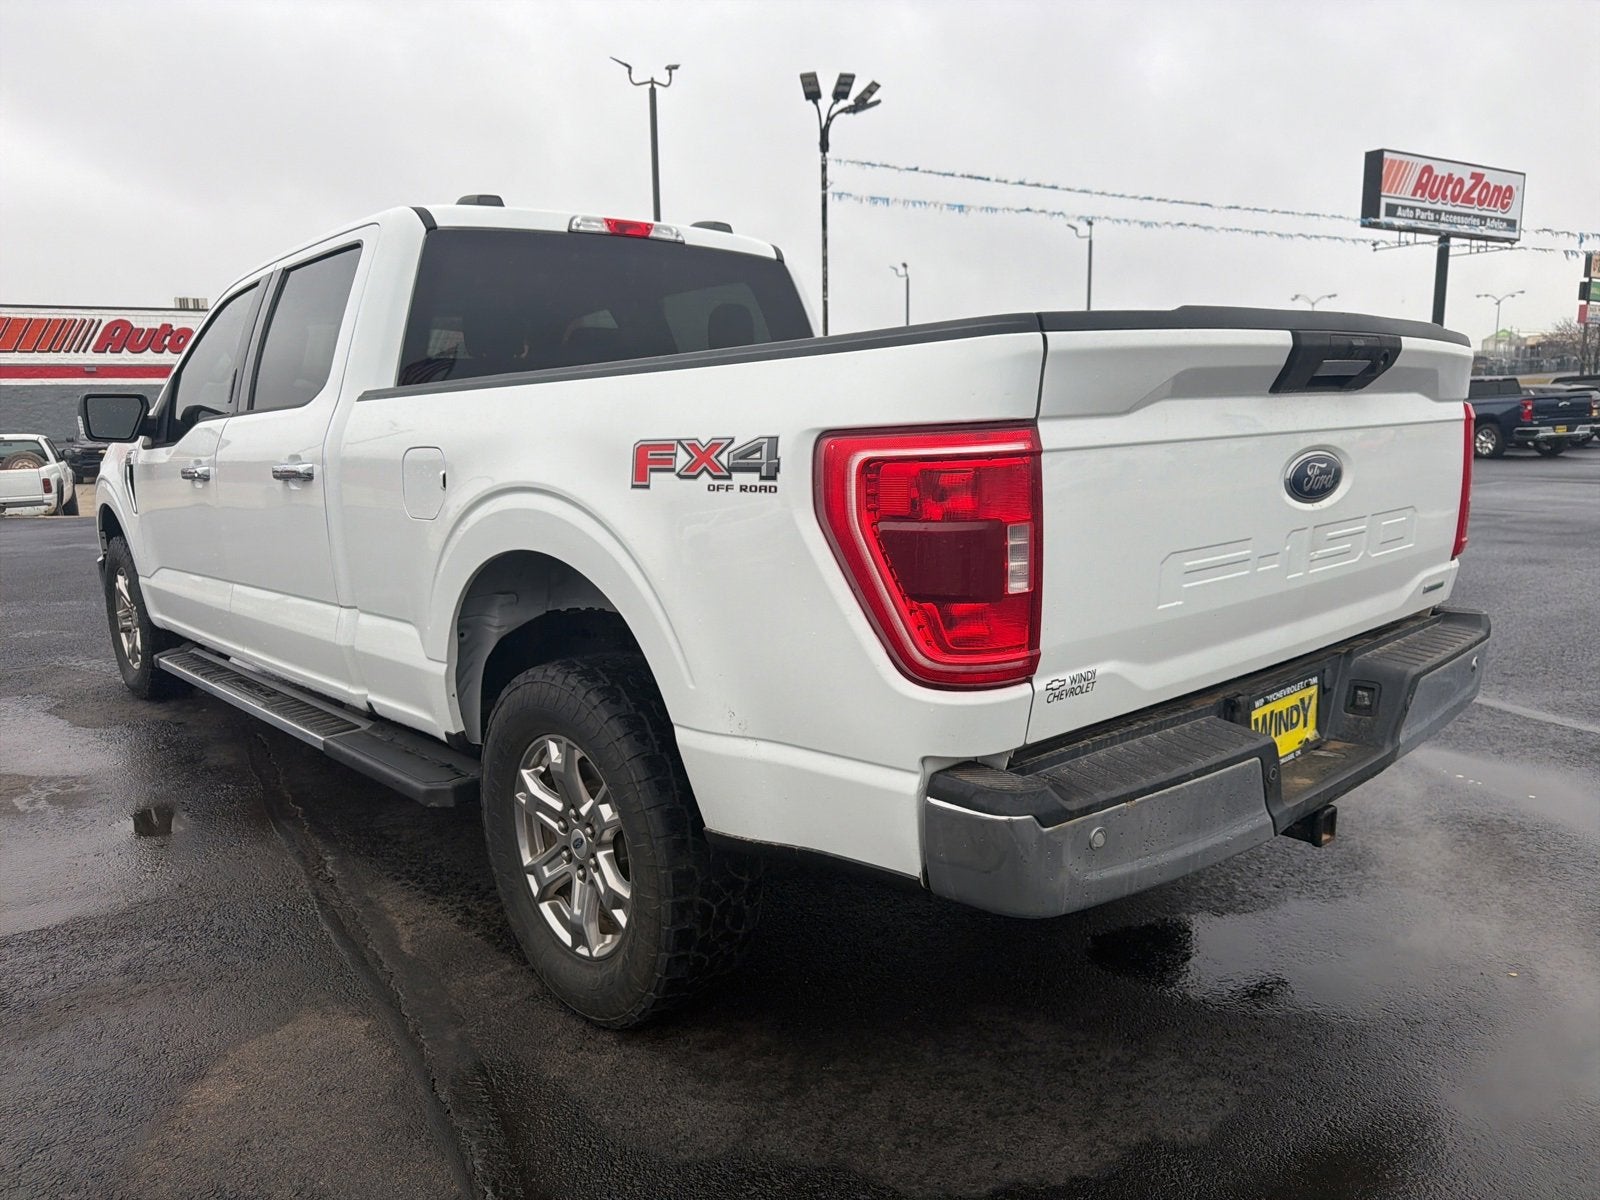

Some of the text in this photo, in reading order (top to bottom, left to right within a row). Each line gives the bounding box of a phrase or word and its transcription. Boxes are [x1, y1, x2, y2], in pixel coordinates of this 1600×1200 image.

[1411, 164, 1515, 211] AutoZone
[1396, 206, 1414, 218] Auto
[1415, 208, 1435, 221] Parts
[1440, 212, 1480, 226] Accessories
[92, 318, 195, 354] Auto
[630, 435, 781, 490] FX4
[1303, 462, 1336, 492] Ford
[707, 484, 778, 494] OFF ROAD
[1157, 505, 1418, 610] F-150
[1046, 681, 1097, 704] CHEVROLET
[1069, 668, 1097, 686] WINDY
[1253, 693, 1315, 738] WINDY
